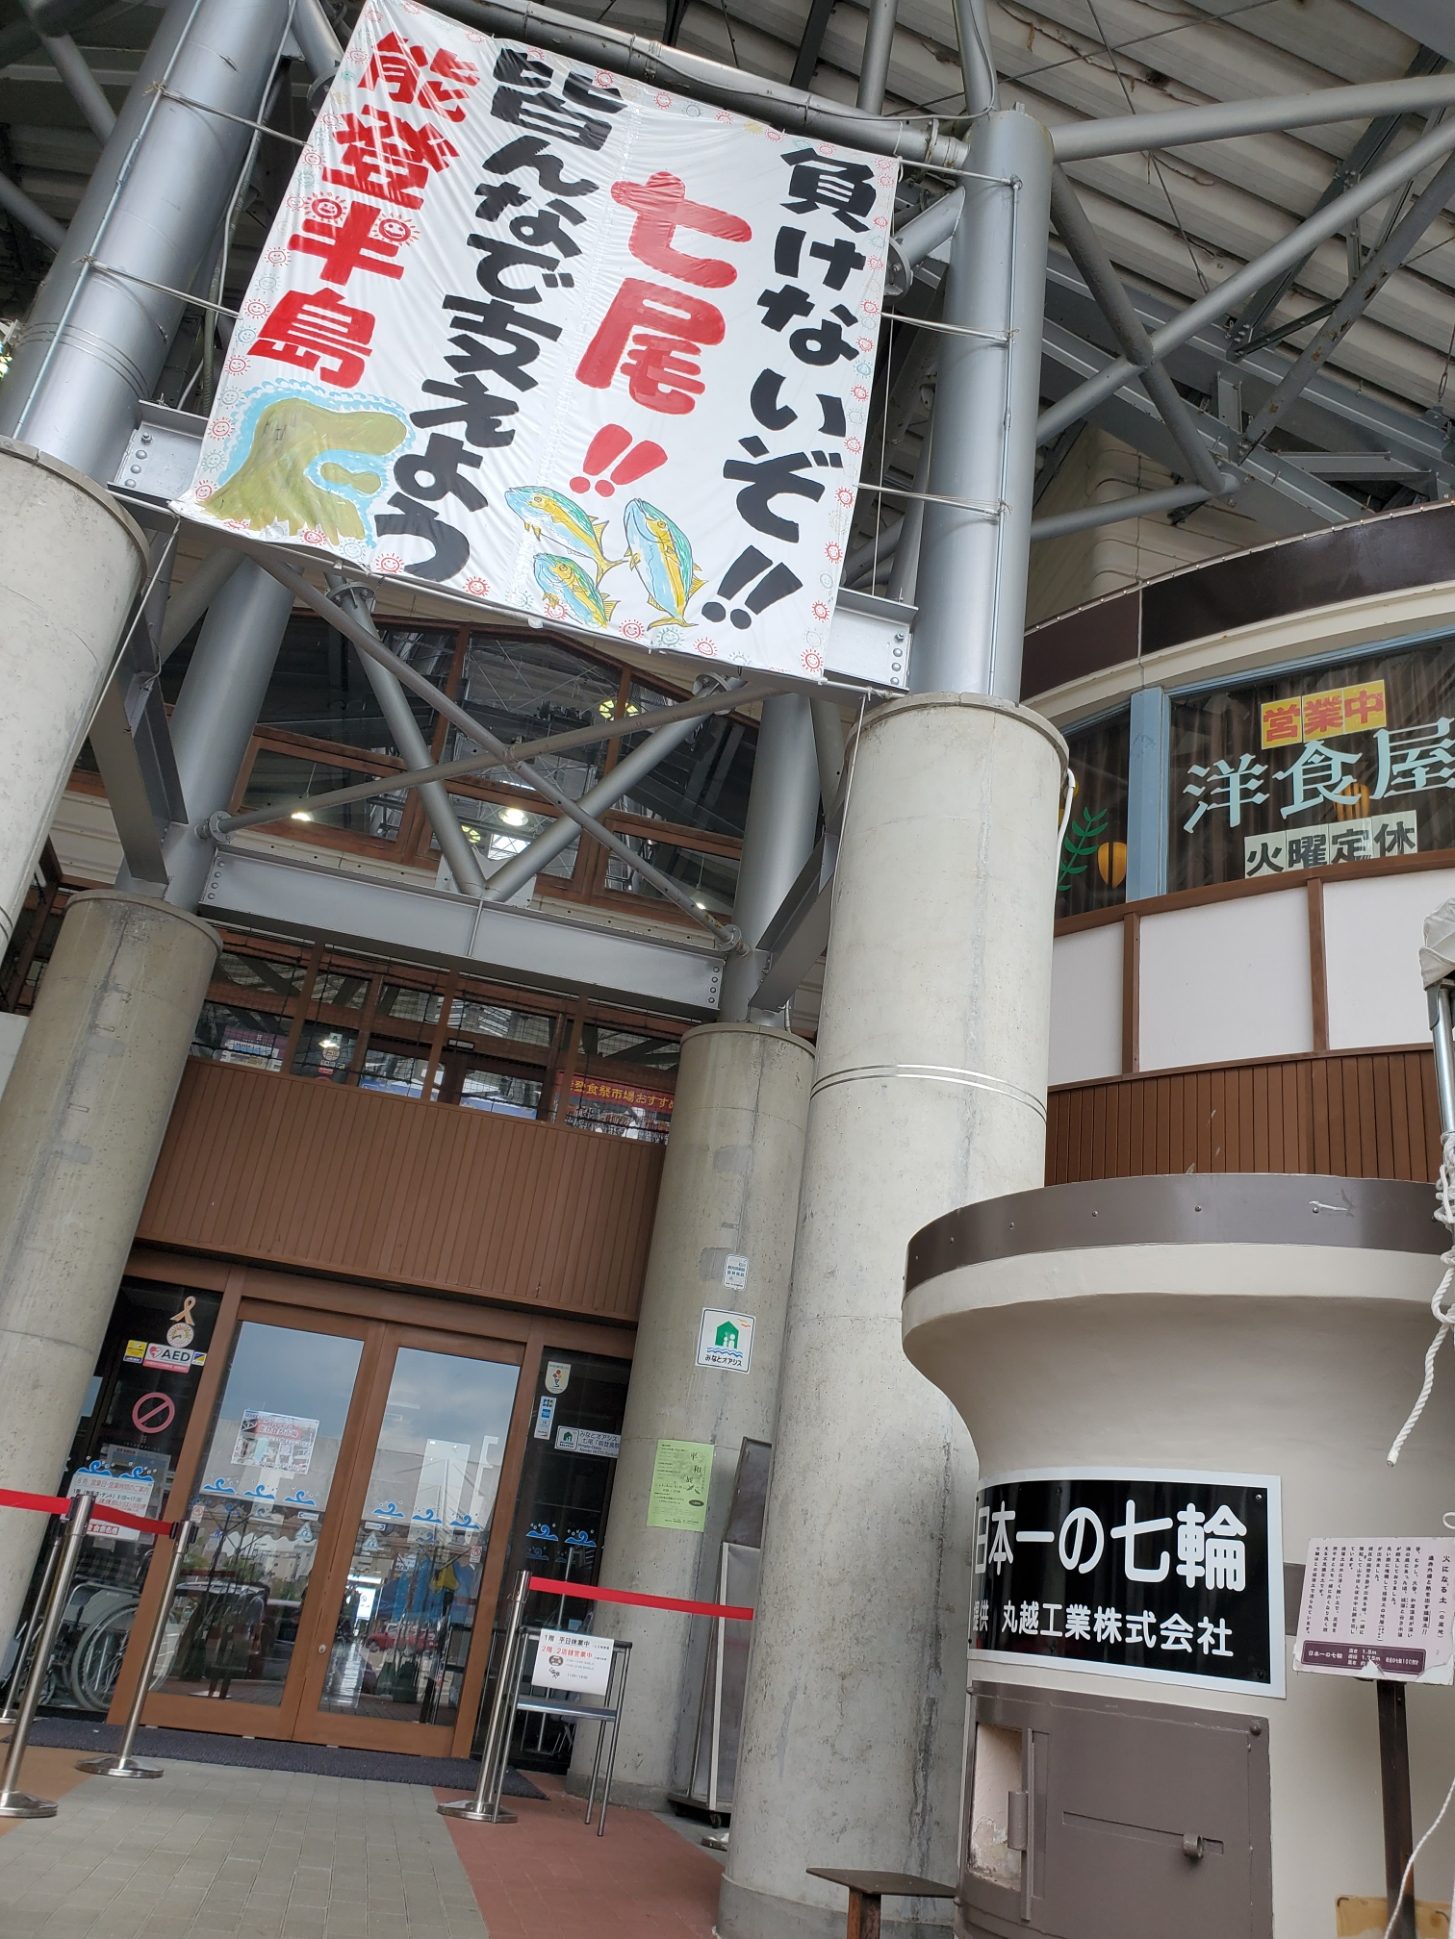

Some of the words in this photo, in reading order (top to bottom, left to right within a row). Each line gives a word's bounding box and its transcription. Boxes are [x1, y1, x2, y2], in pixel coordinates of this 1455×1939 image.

[247, 30, 480, 389] 能登半島
[373, 47, 628, 582] 皆んなで支えよう
[1262, 688, 1386, 743] 営業中
[1183, 717, 1455, 835] 洋食屋
[1246, 820, 1417, 877] 火曜定休
[162, 1348, 191, 1362] AED
[974, 1500, 1247, 1592] 日本一の七輪
[1001, 1599, 1234, 1658] 丸越工業株式会社
